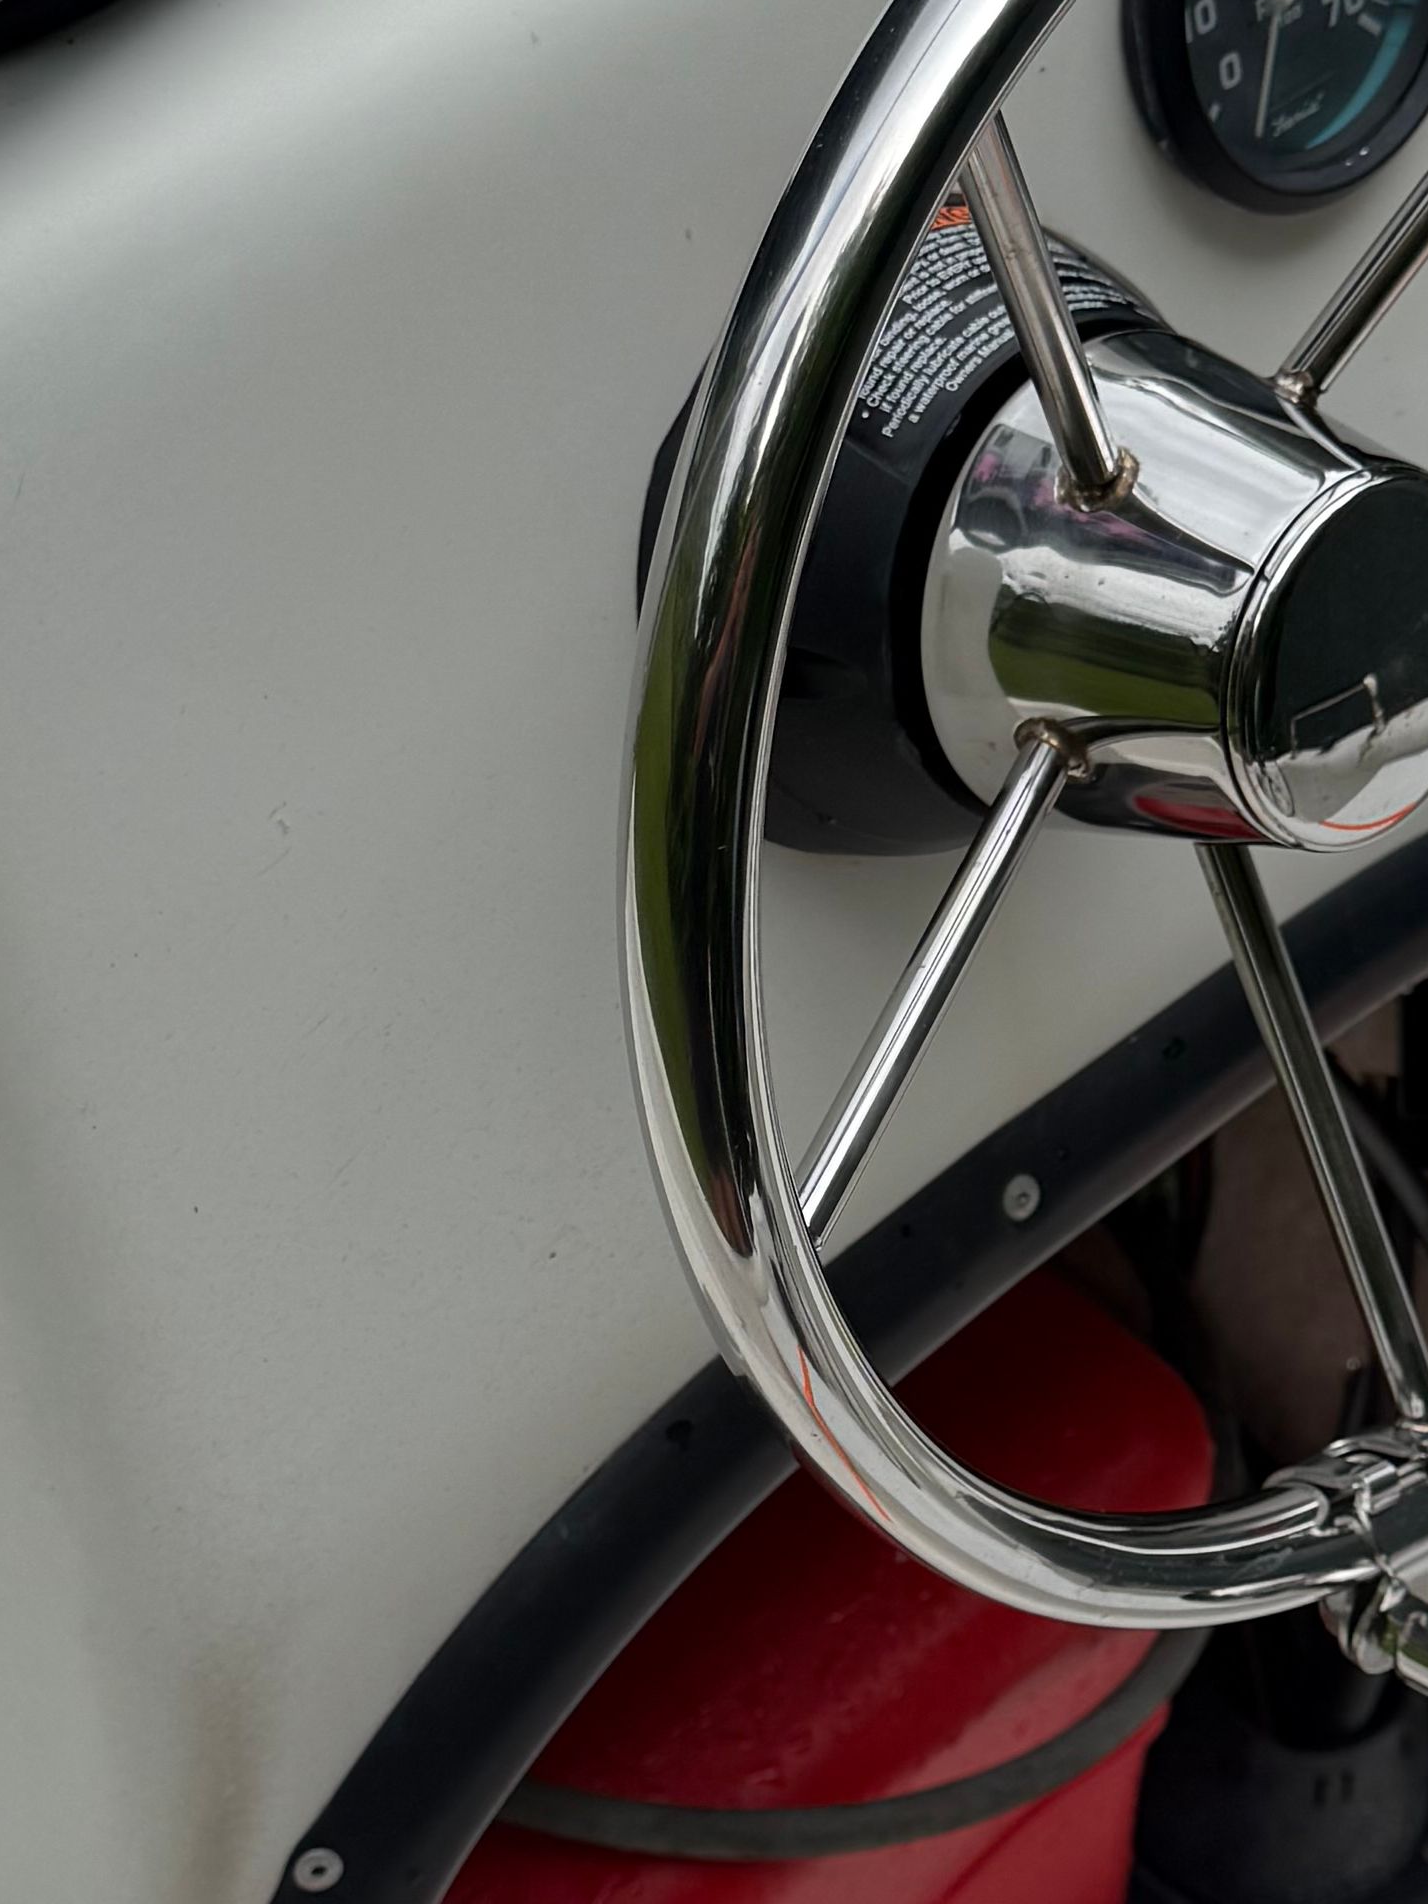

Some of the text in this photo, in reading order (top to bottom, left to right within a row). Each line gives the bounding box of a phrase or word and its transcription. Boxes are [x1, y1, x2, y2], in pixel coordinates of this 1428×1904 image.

[1219, 52, 1241, 90] 0
[903, 327, 917, 340] or
[866, 373, 896, 407] Check
[892, 335, 931, 372] steering
[886, 370, 914, 403] found
[913, 357, 960, 413] waterproof
[945, 356, 982, 392] Owners
[881, 375, 930, 438] Periodically
